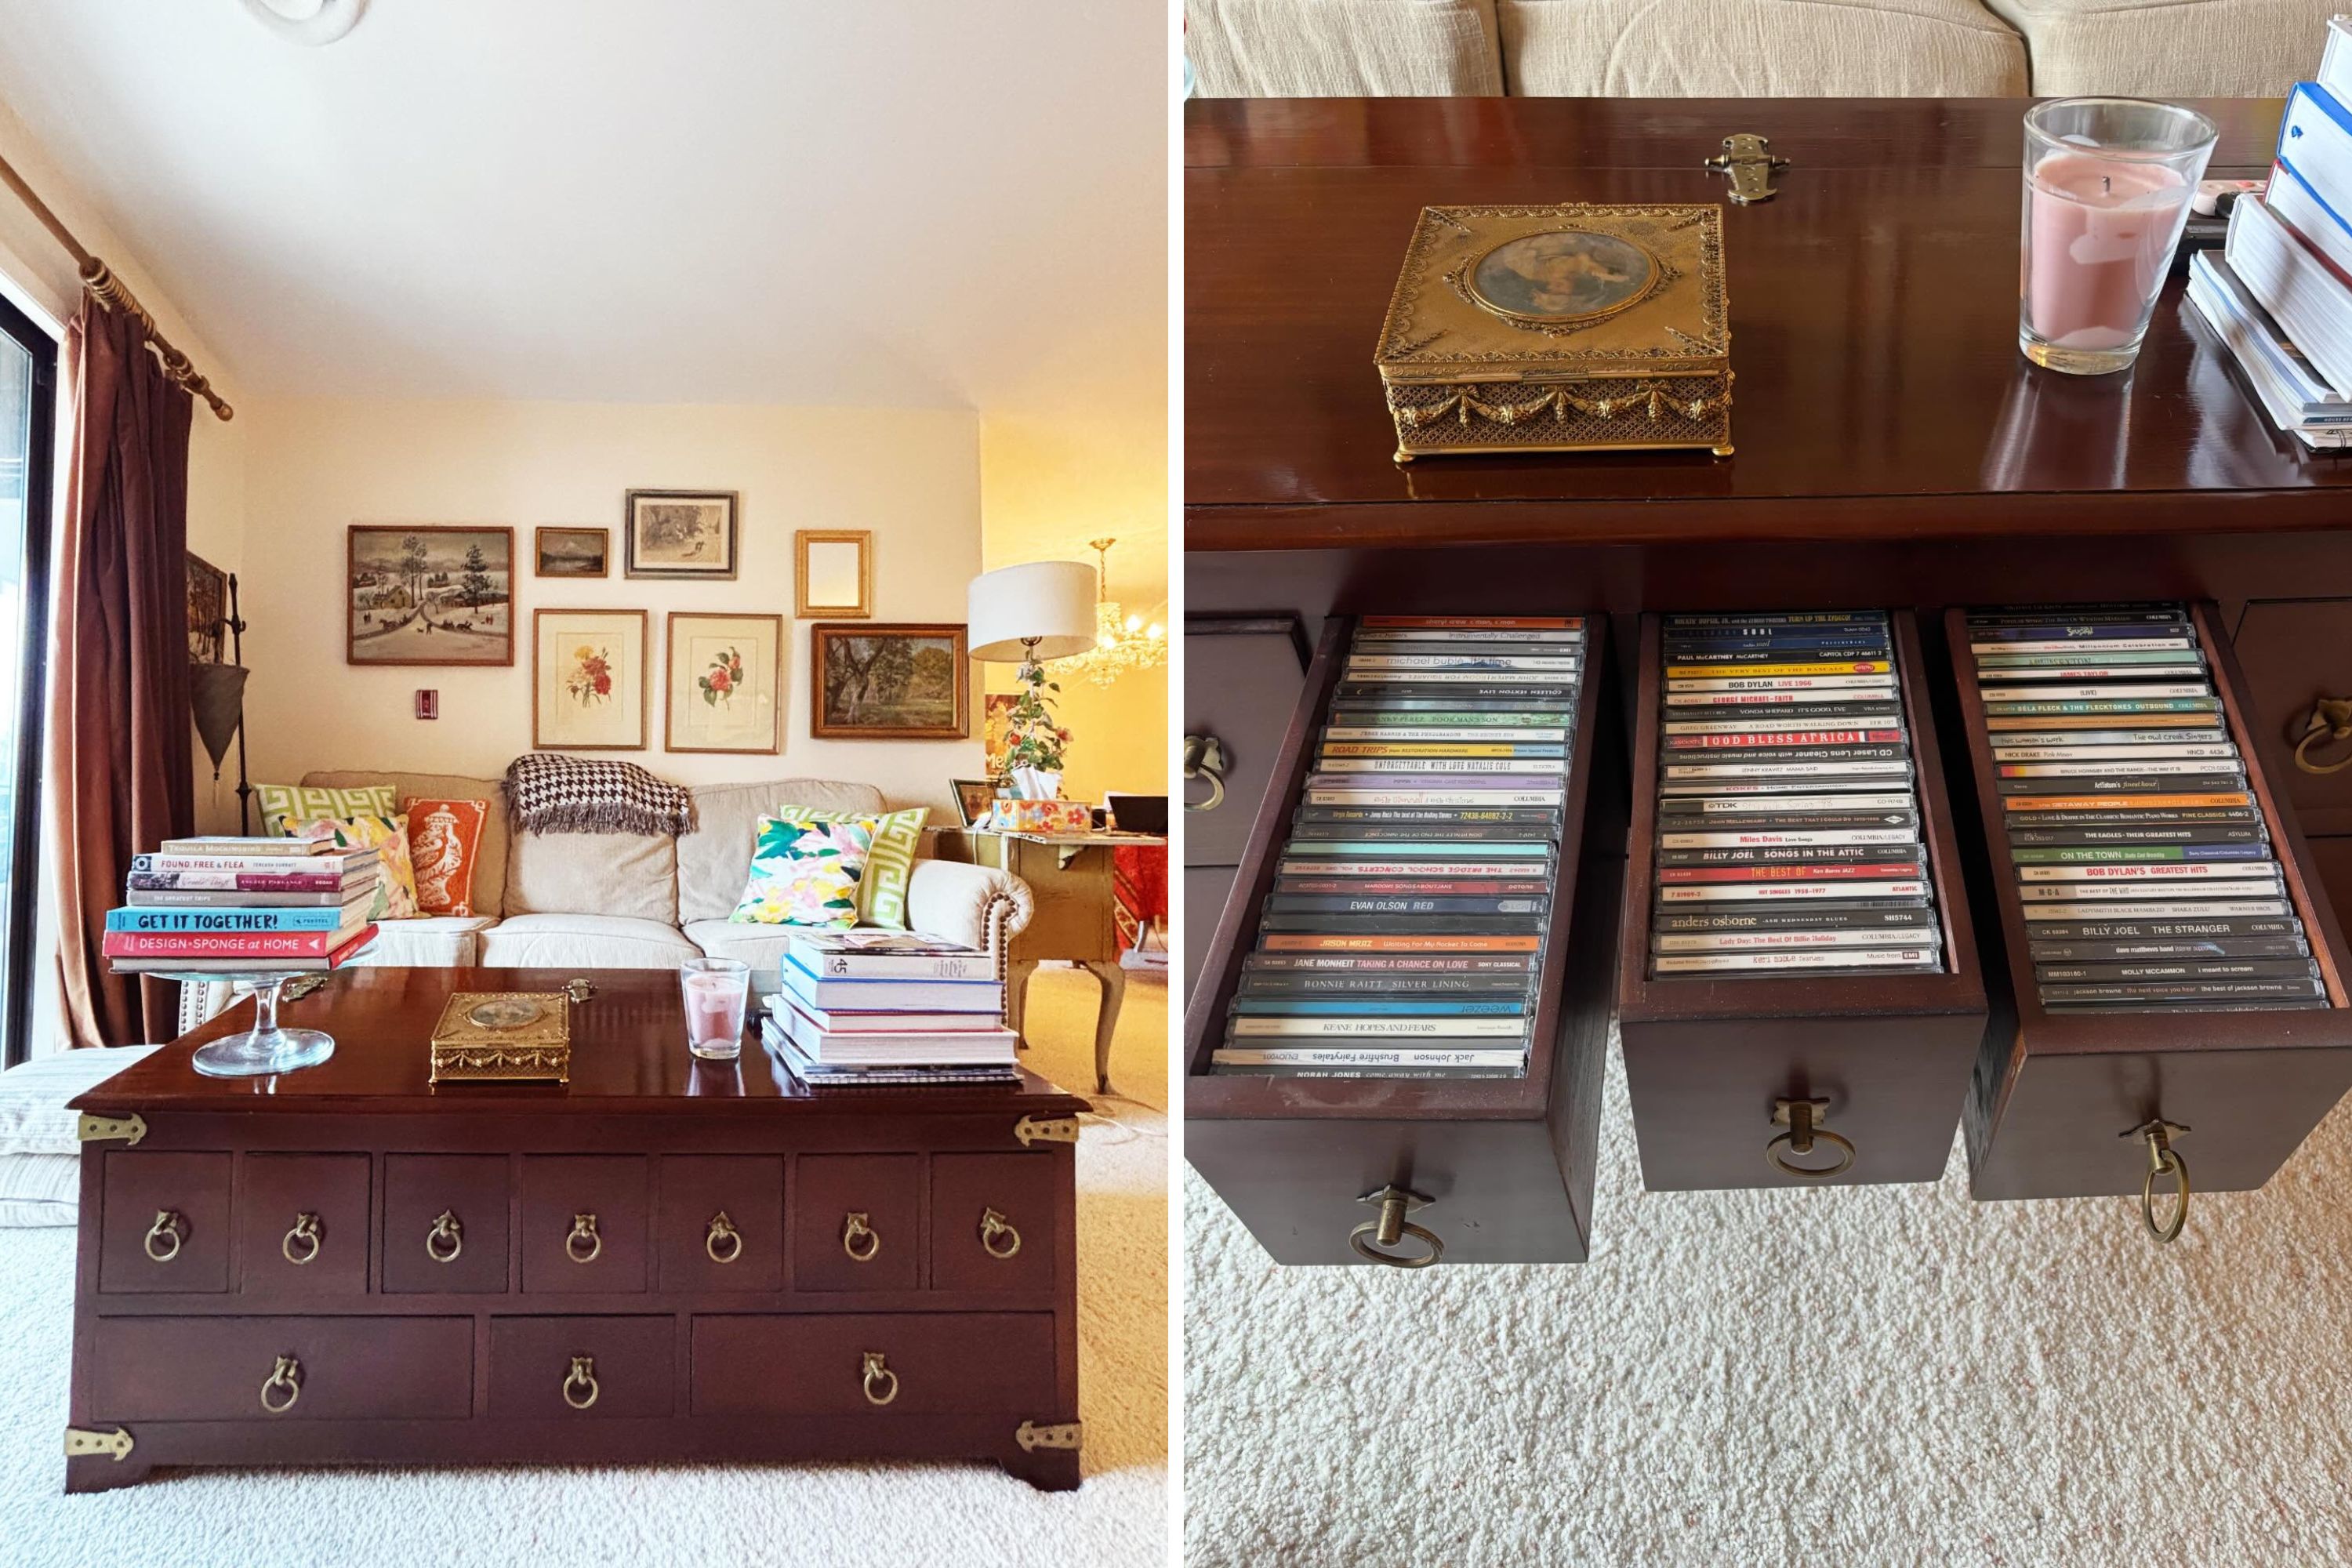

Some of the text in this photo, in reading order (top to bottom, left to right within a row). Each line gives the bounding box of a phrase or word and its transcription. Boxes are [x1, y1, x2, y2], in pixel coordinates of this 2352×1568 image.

[1470, 656, 1486, 665] it's
[1712, 735, 1739, 744] GOD
[1748, 735, 1793, 743] BLESS
[1800, 732, 1854, 742] AFRICA
[2097, 851, 2122, 859] TOWN
[1751, 867, 1806, 877] THE BEST OF
[2107, 867, 2145, 876] DYLAN'S
[2151, 866, 2188, 875] GREATEST
[138, 915, 278, 929] GET IT TOGETHER!
[1671, 916, 1709, 927] anders
[1712, 916, 1757, 926] osborne
[2083, 927, 2111, 935] BILLY
[2114, 926, 2140, 935] JOEL
[248, 941, 260, 949] at
[263, 939, 299, 949] HOME
[1446, 960, 1468, 969] LOVE
[1305, 980, 1345, 989] BONNIE
[1312, 1054, 1356, 1062] Fairytales
[1359, 1054, 1399, 1062] Brushfire
